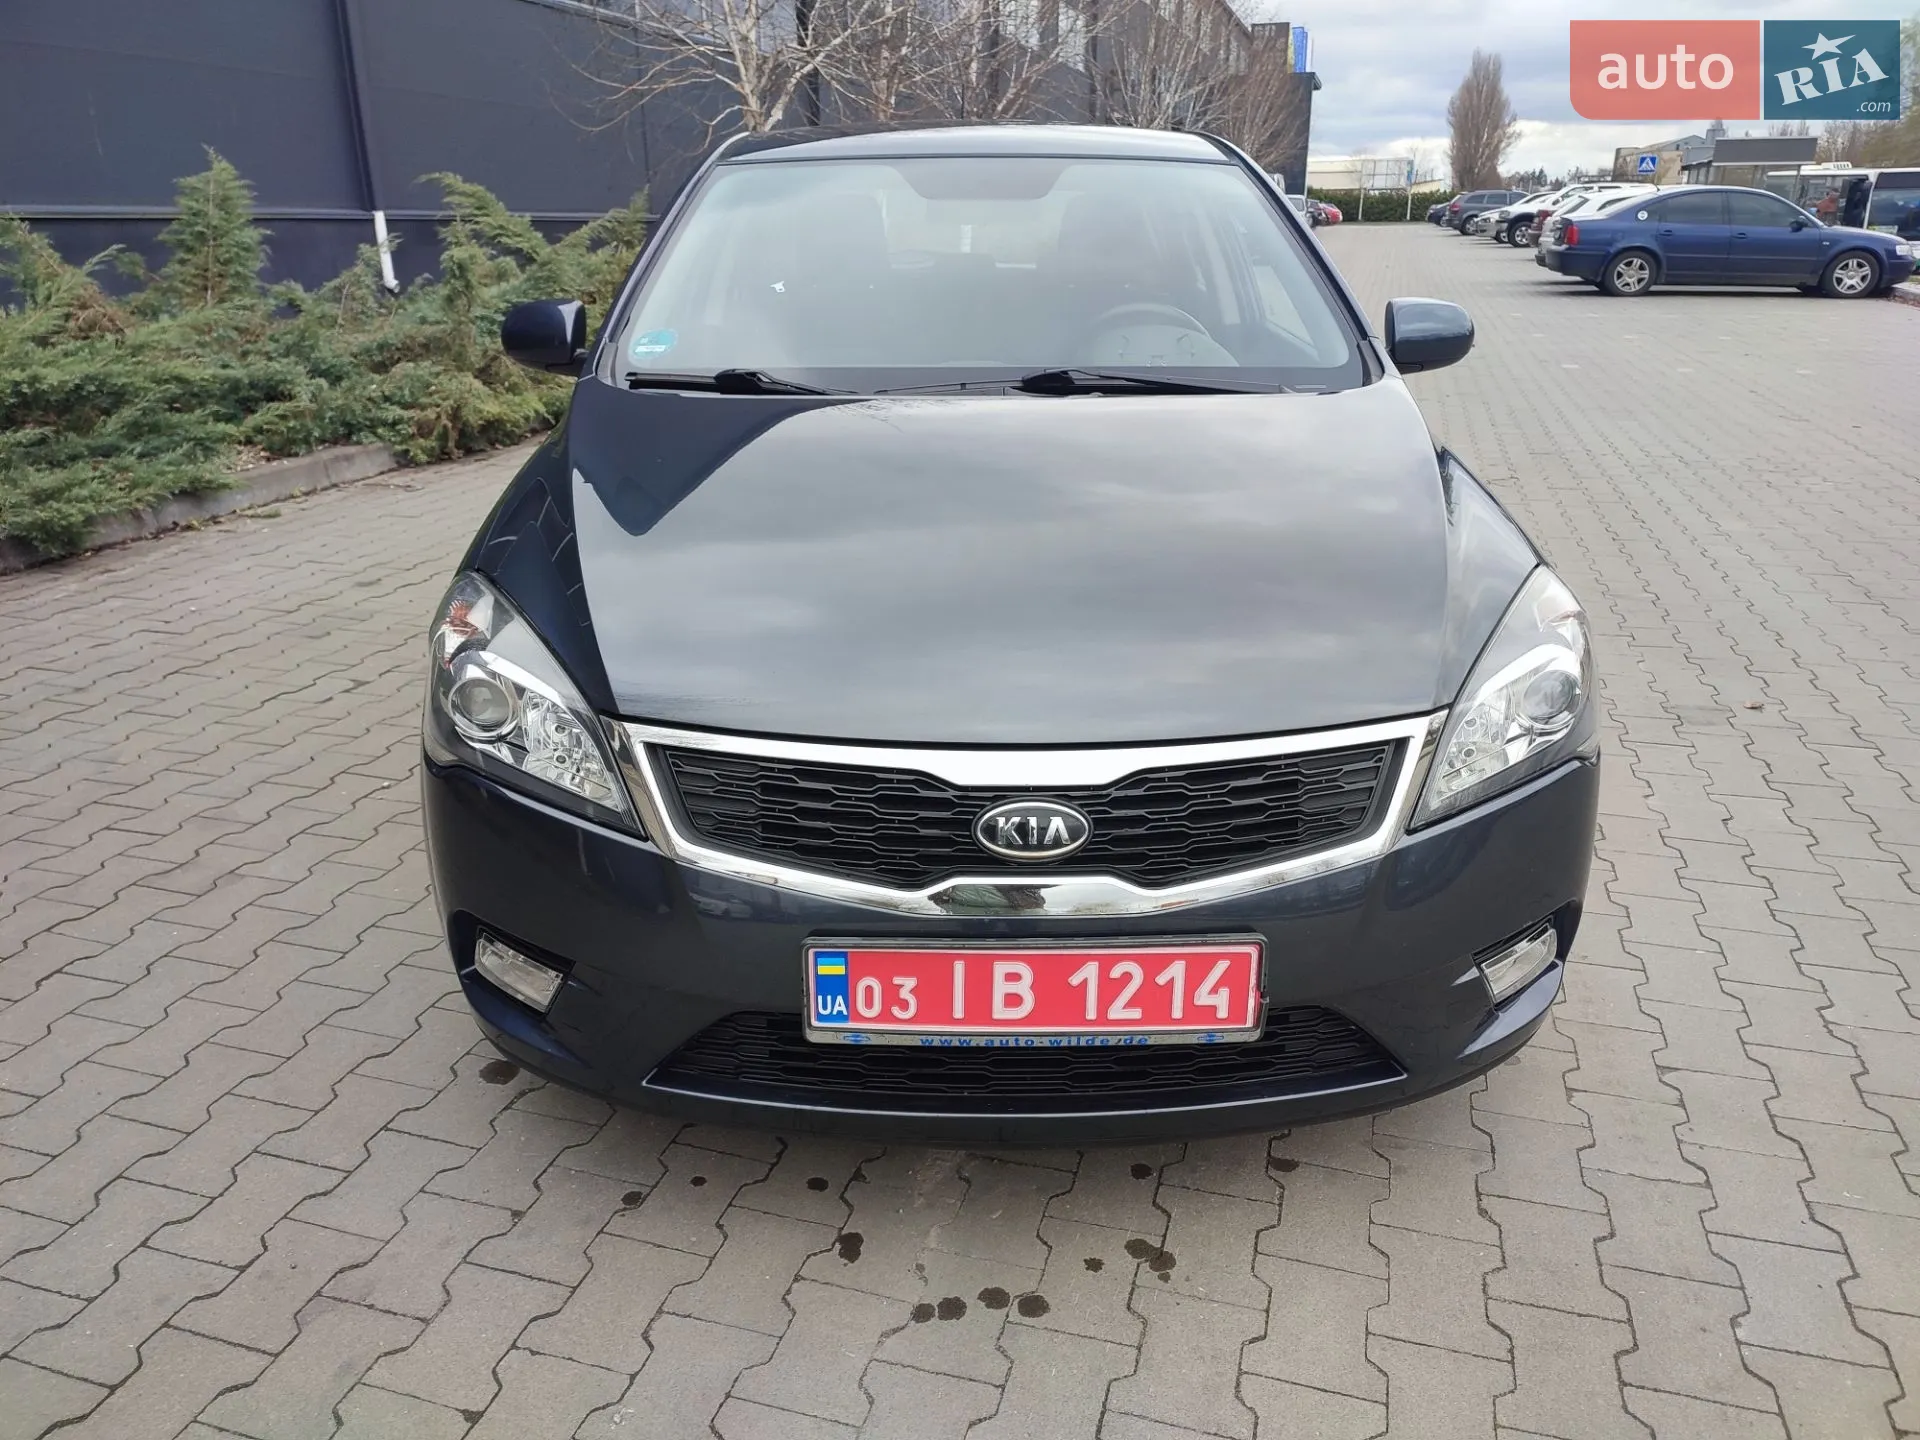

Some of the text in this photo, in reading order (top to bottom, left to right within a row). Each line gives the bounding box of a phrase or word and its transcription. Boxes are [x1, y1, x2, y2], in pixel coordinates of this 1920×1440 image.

[996, 816, 1071, 845] KIA
[855, 961, 1230, 1019] 03 IB 1214
[818, 995, 848, 1016] UA
